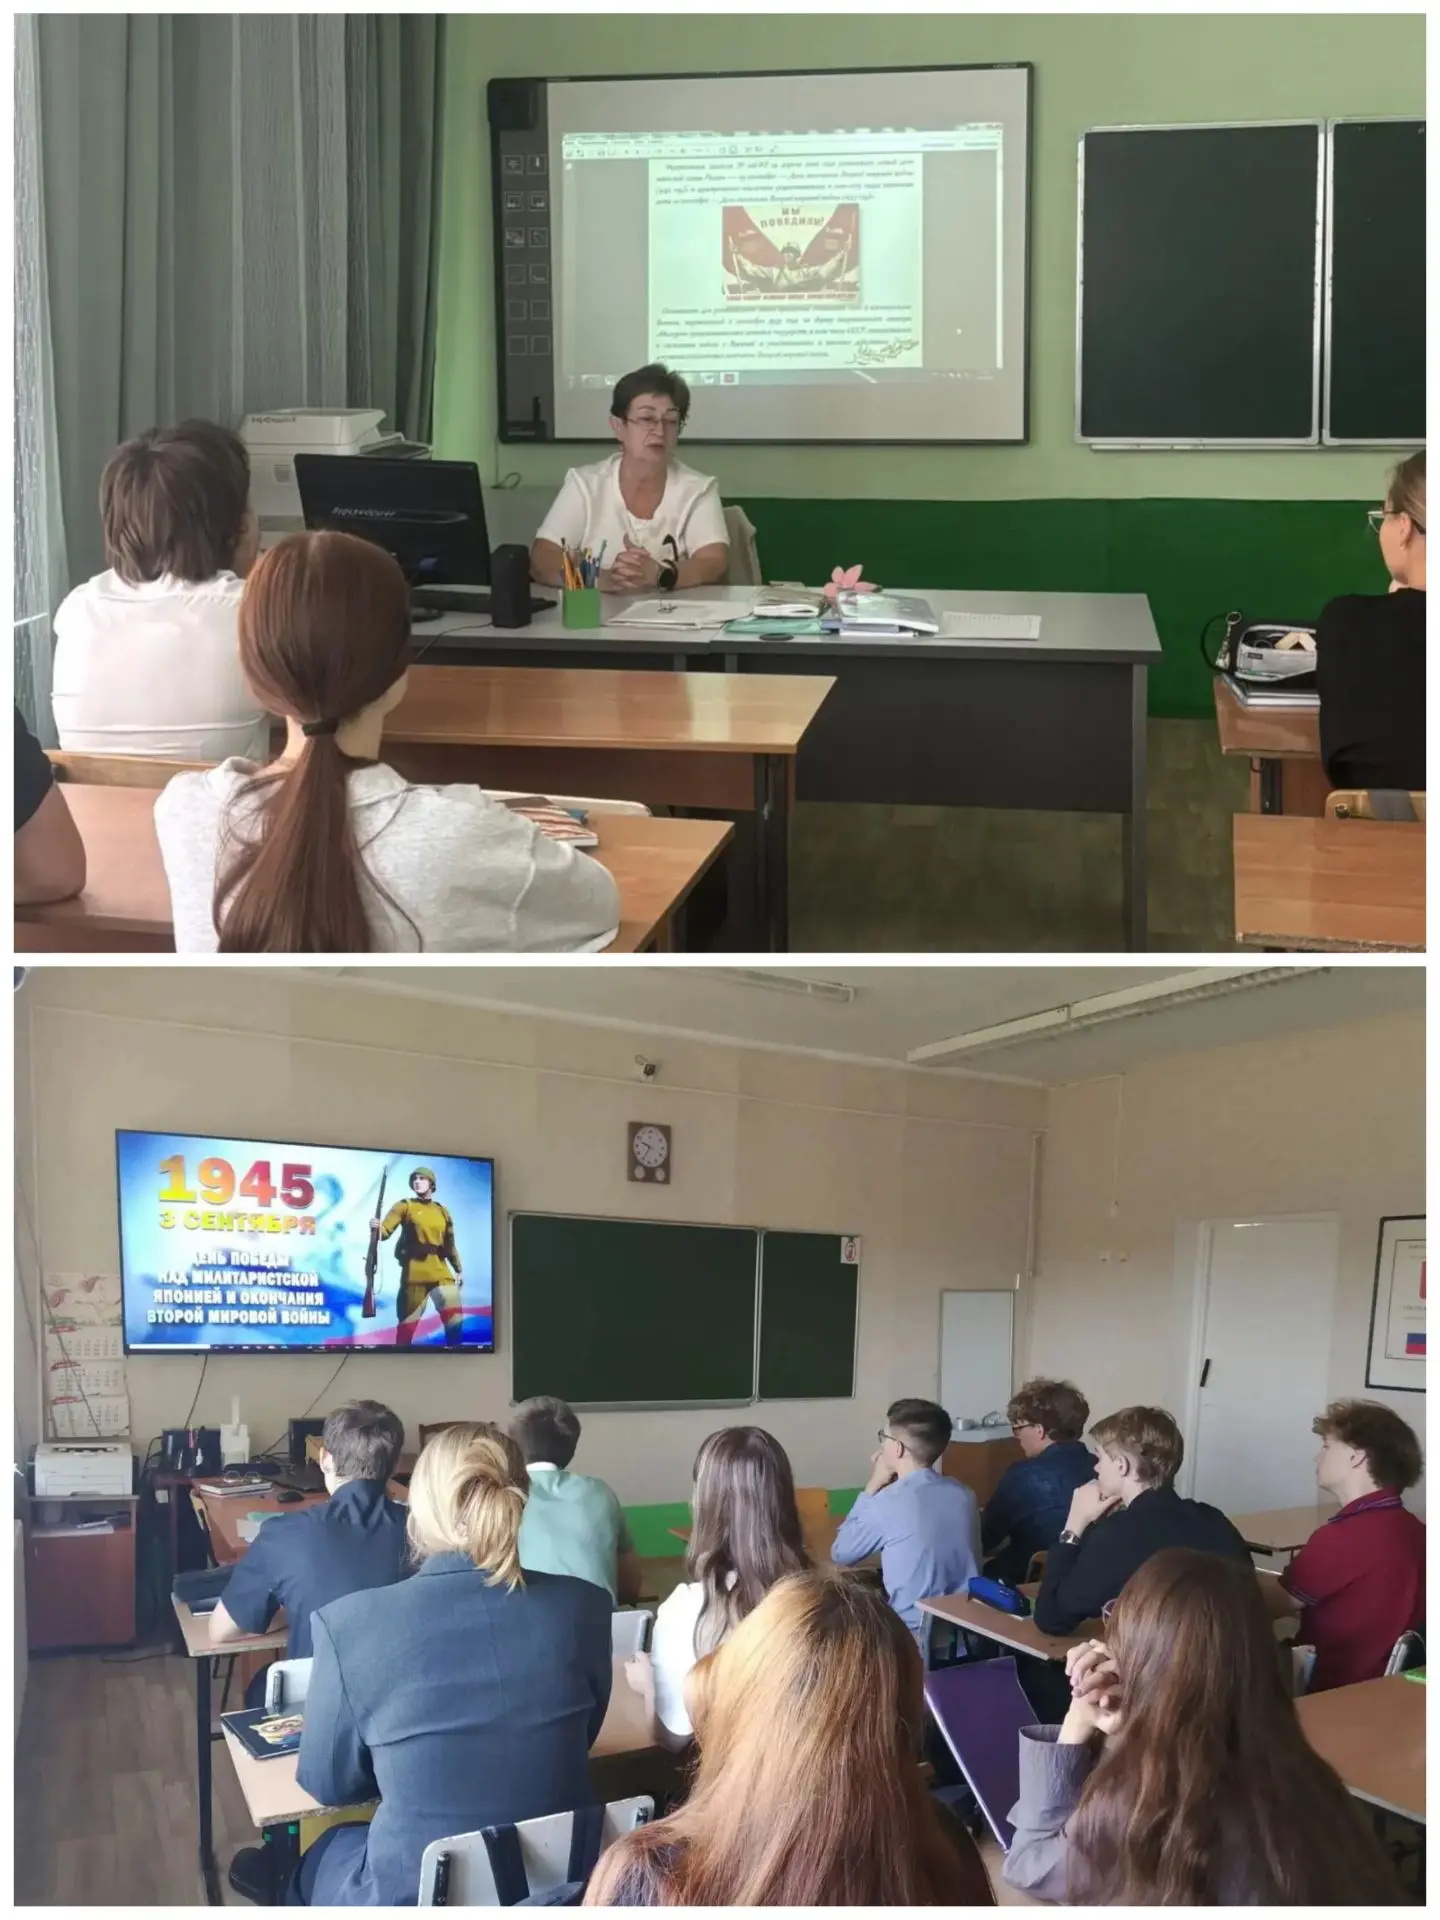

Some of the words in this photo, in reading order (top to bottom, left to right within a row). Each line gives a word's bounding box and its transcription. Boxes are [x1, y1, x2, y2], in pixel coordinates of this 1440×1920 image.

[159, 1154, 315, 1210] 1945
[159, 1210, 175, 1230] 3
[183, 1210, 316, 1236] СЕНТЯБРЯ
[230, 1251, 291, 1268] ПОБЕДЫ
[158, 1270, 188, 1286] НАД
[191, 1269, 319, 1287] МИЛИТАРИСТСКОЙ
[153, 1287, 222, 1304] ЯПОНИЕЙ
[226, 1290, 236, 1305] И
[240, 1291, 324, 1306] ОКОНЧАНИЯ
[147, 1306, 204, 1324] ВТОРОЙ
[208, 1307, 277, 1325] МИРОВОЙ
[281, 1307, 331, 1325] ВОЙНЫ
